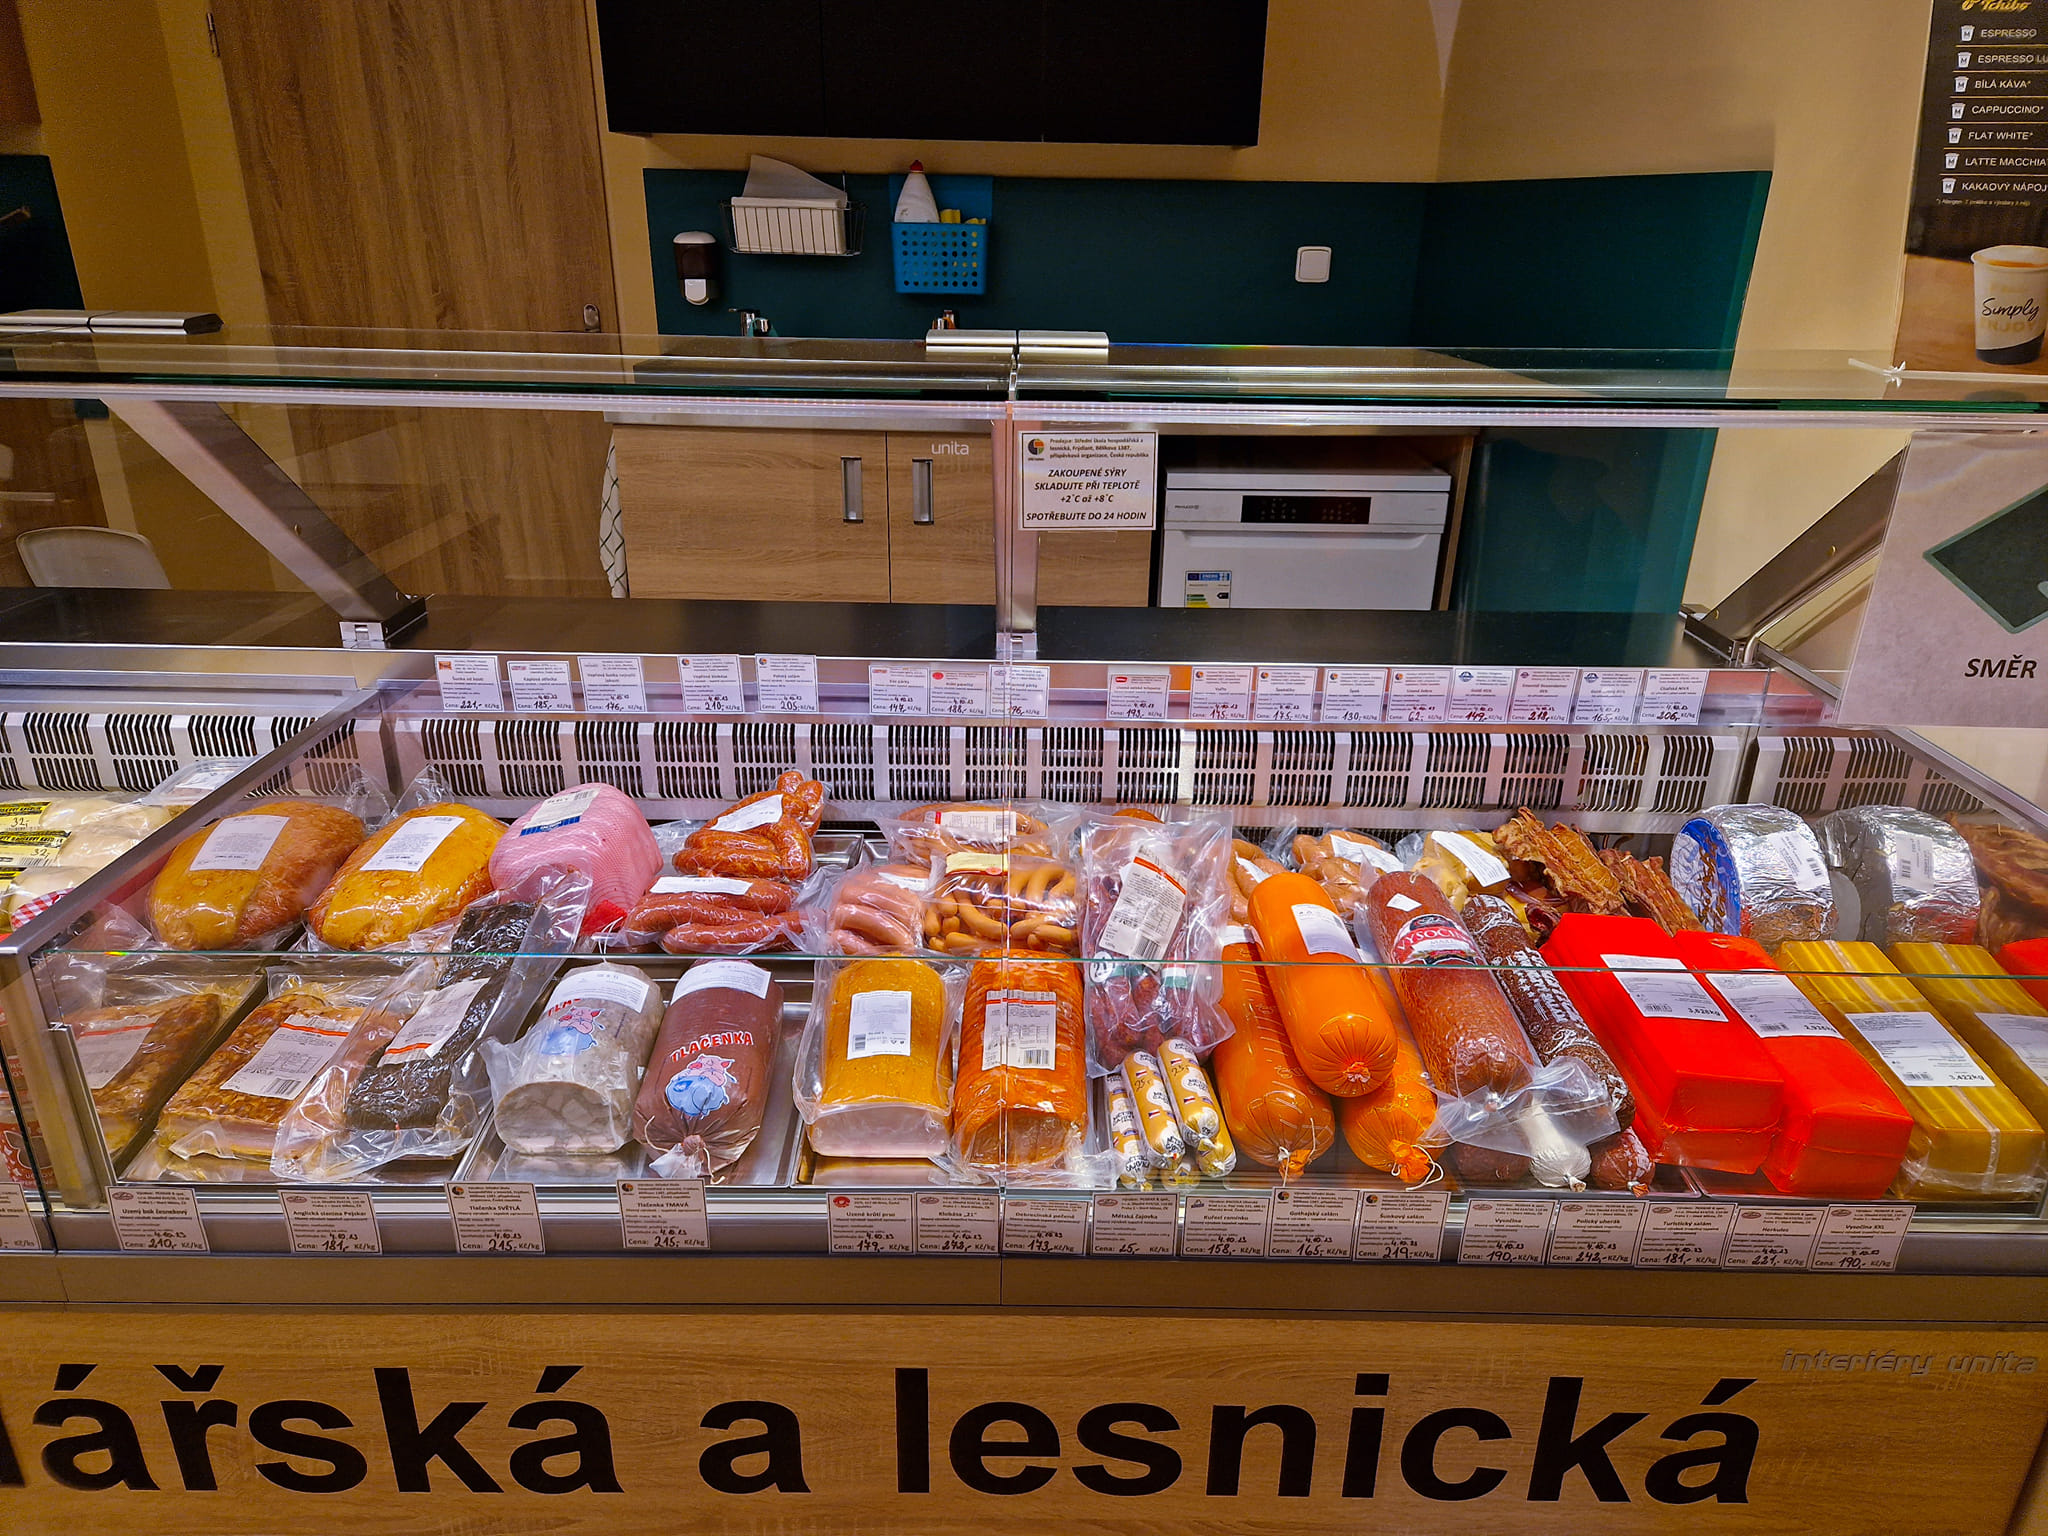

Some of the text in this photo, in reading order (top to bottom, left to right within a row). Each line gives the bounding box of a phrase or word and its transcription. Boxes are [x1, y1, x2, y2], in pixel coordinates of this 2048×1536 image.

[1981, 28, 2037, 38] ESPRESSO
[1978, 55, 2034, 63] ESPRESSO
[1975, 79, 1996, 89] BÍLÁ
[1968, 131, 1994, 140] FLAT
[1965, 157, 2048, 166] LATTE MACCHIA
[1961, 181, 2011, 191] KAKAOVÝ
[1982, 298, 2039, 322] Simply
[931, 441, 969, 455] unita
[1048, 466, 1127, 477] ZAKOUPENÉ SÝRY
[1034, 480, 1140, 490] SKLADUJTE PŘI TEPLOTĚ
[1082, 493, 1093, 503] až
[1026, 511, 1146, 521] SPOTŘEBUJTE DO 24 HODIN
[1964, 654, 2037, 678] SMĚR
[670, 1031, 755, 1063] TLAČENKA
[322, 1240, 350, 1253] 181,-
[1781, 1348, 2039, 1377] interiéry unita
[0, 1363, 1760, 1505] ářská a lesnická
